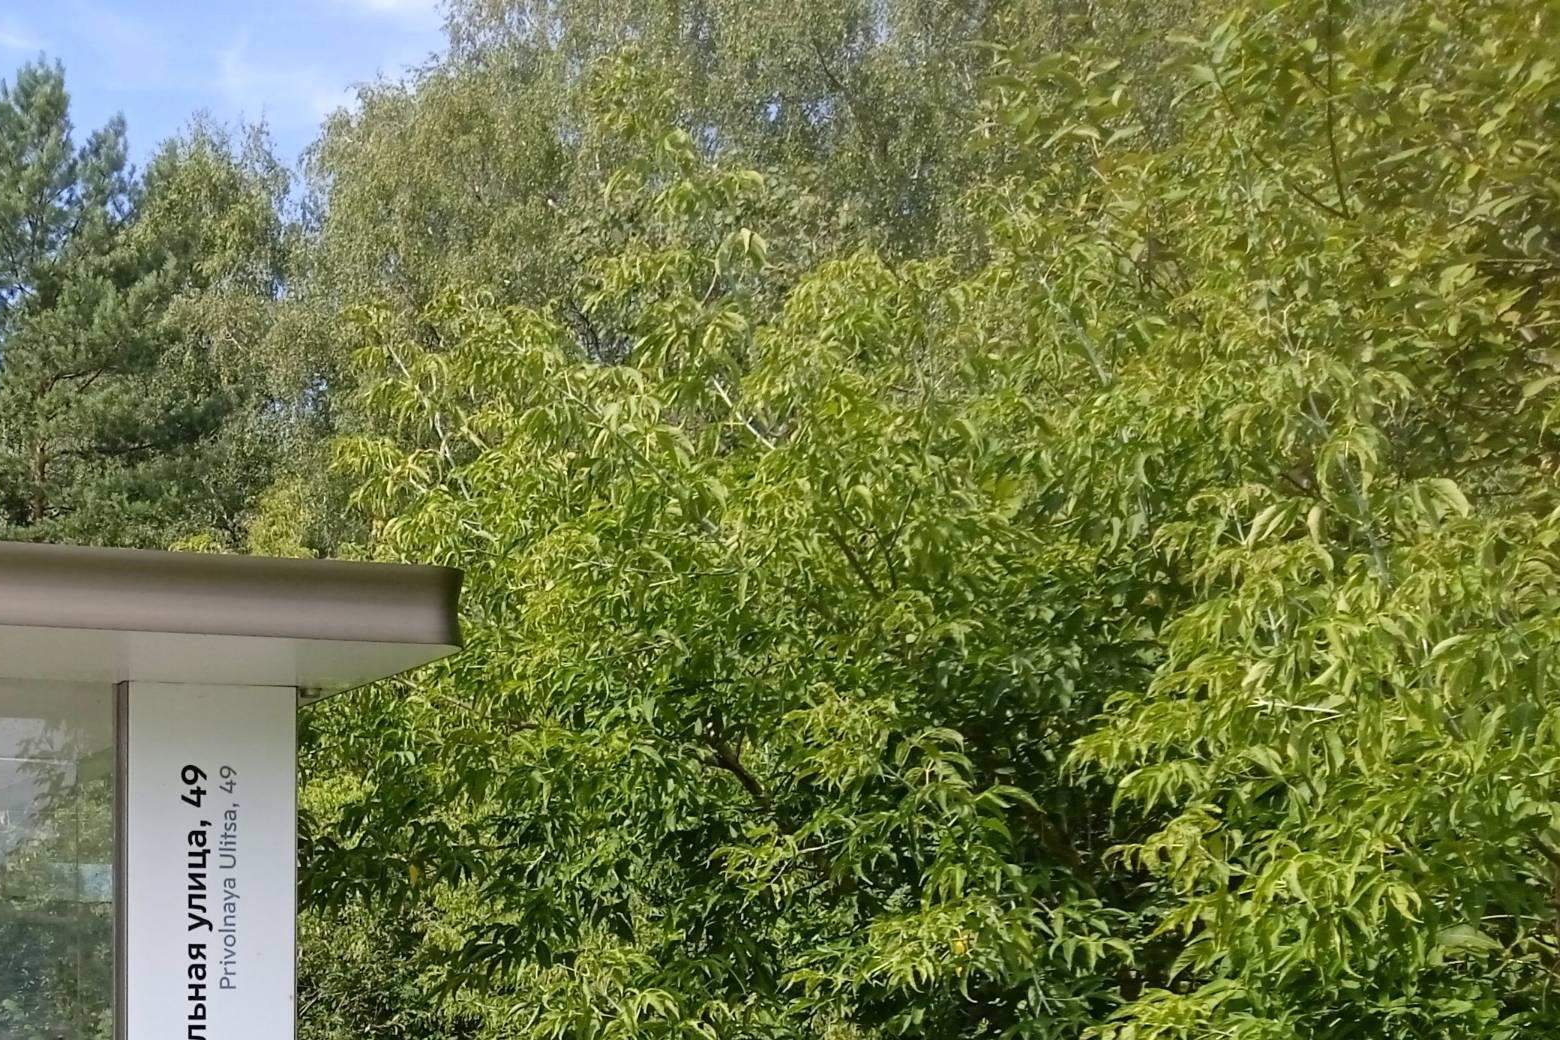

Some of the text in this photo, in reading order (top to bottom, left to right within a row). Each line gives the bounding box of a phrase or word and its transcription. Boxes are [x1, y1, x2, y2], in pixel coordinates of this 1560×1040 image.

[181, 764, 208, 808] 49
[187, 819, 213, 931] улица,
[218, 765, 241, 990] Privolnaya Ulitsa, 49
